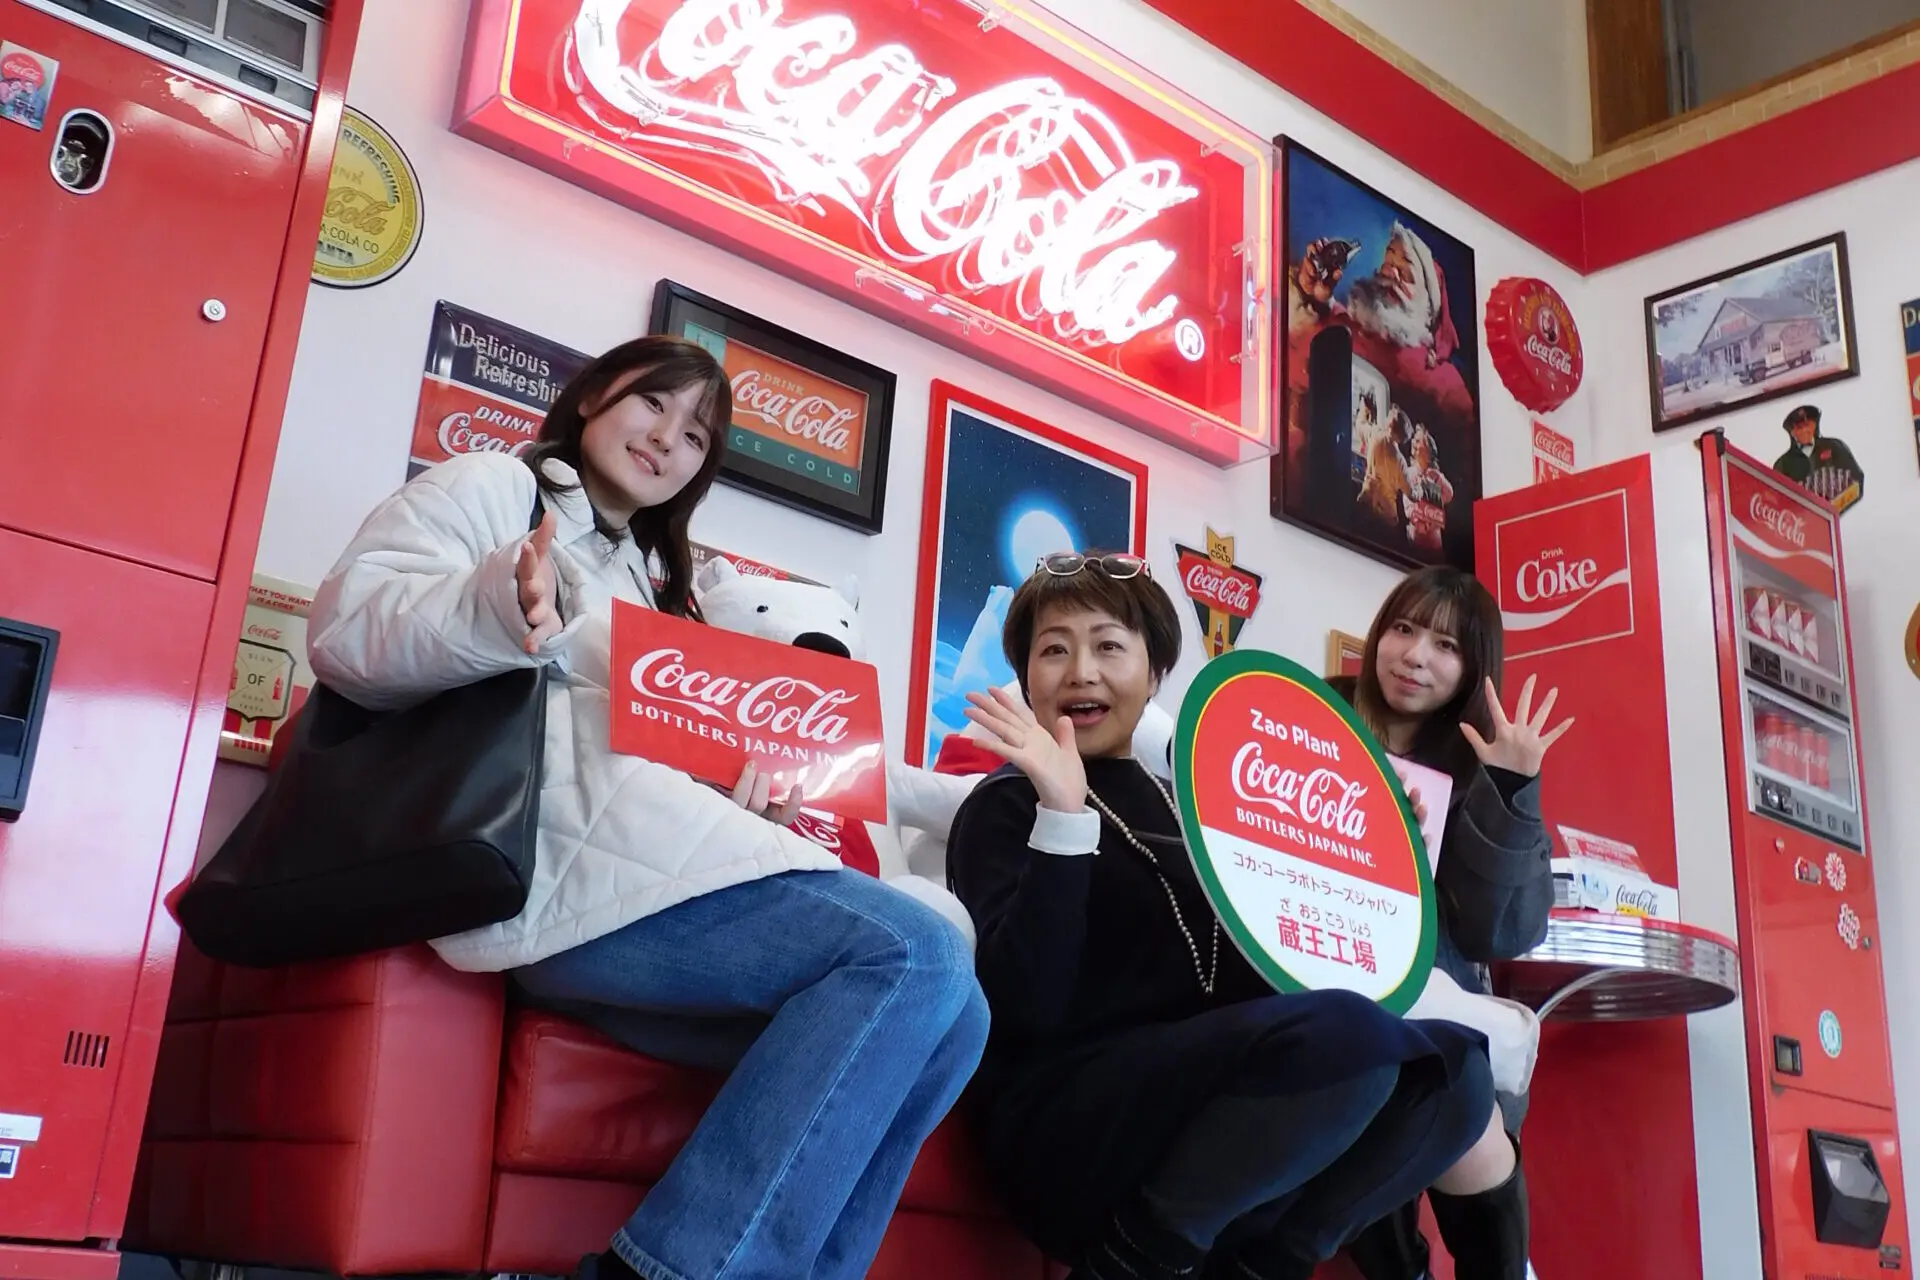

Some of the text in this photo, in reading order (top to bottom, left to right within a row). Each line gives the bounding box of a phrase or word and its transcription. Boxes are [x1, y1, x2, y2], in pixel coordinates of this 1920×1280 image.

[341, 128, 401, 205] REFRESHING
[329, 226, 361, 247] COLA
[459, 321, 551, 377] Delicious
[473, 353, 563, 404] Refreshi
[762, 372, 805, 395] DRINK
[473, 403, 536, 436] DRINK
[730, 369, 860, 451] Coca-Cola
[735, 434, 852, 485] CE COLD
[1749, 491, 1807, 548] Coca-Cola
[1210, 549, 1232, 563] COLD
[1214, 542, 1228, 554] ICE
[1541, 547, 1564, 560] Drink
[1186, 564, 1253, 611] Coca-Cola
[1516, 558, 1598, 603] Coke
[247, 673, 266, 686] OF
[630, 648, 860, 744] Coca-Cola
[630, 700, 738, 748] BOTTLERS
[744, 737, 810, 762] JAPAN
[1250, 708, 1341, 762] Zao Plant
[1231, 741, 1369, 840] Coca-Cola
[1236, 806, 1377, 868] BOTTLERS JAPAN INC.
[1615, 884, 1659, 916] Coca-Cola
[1276, 914, 1377, 974] 蔵王工場
